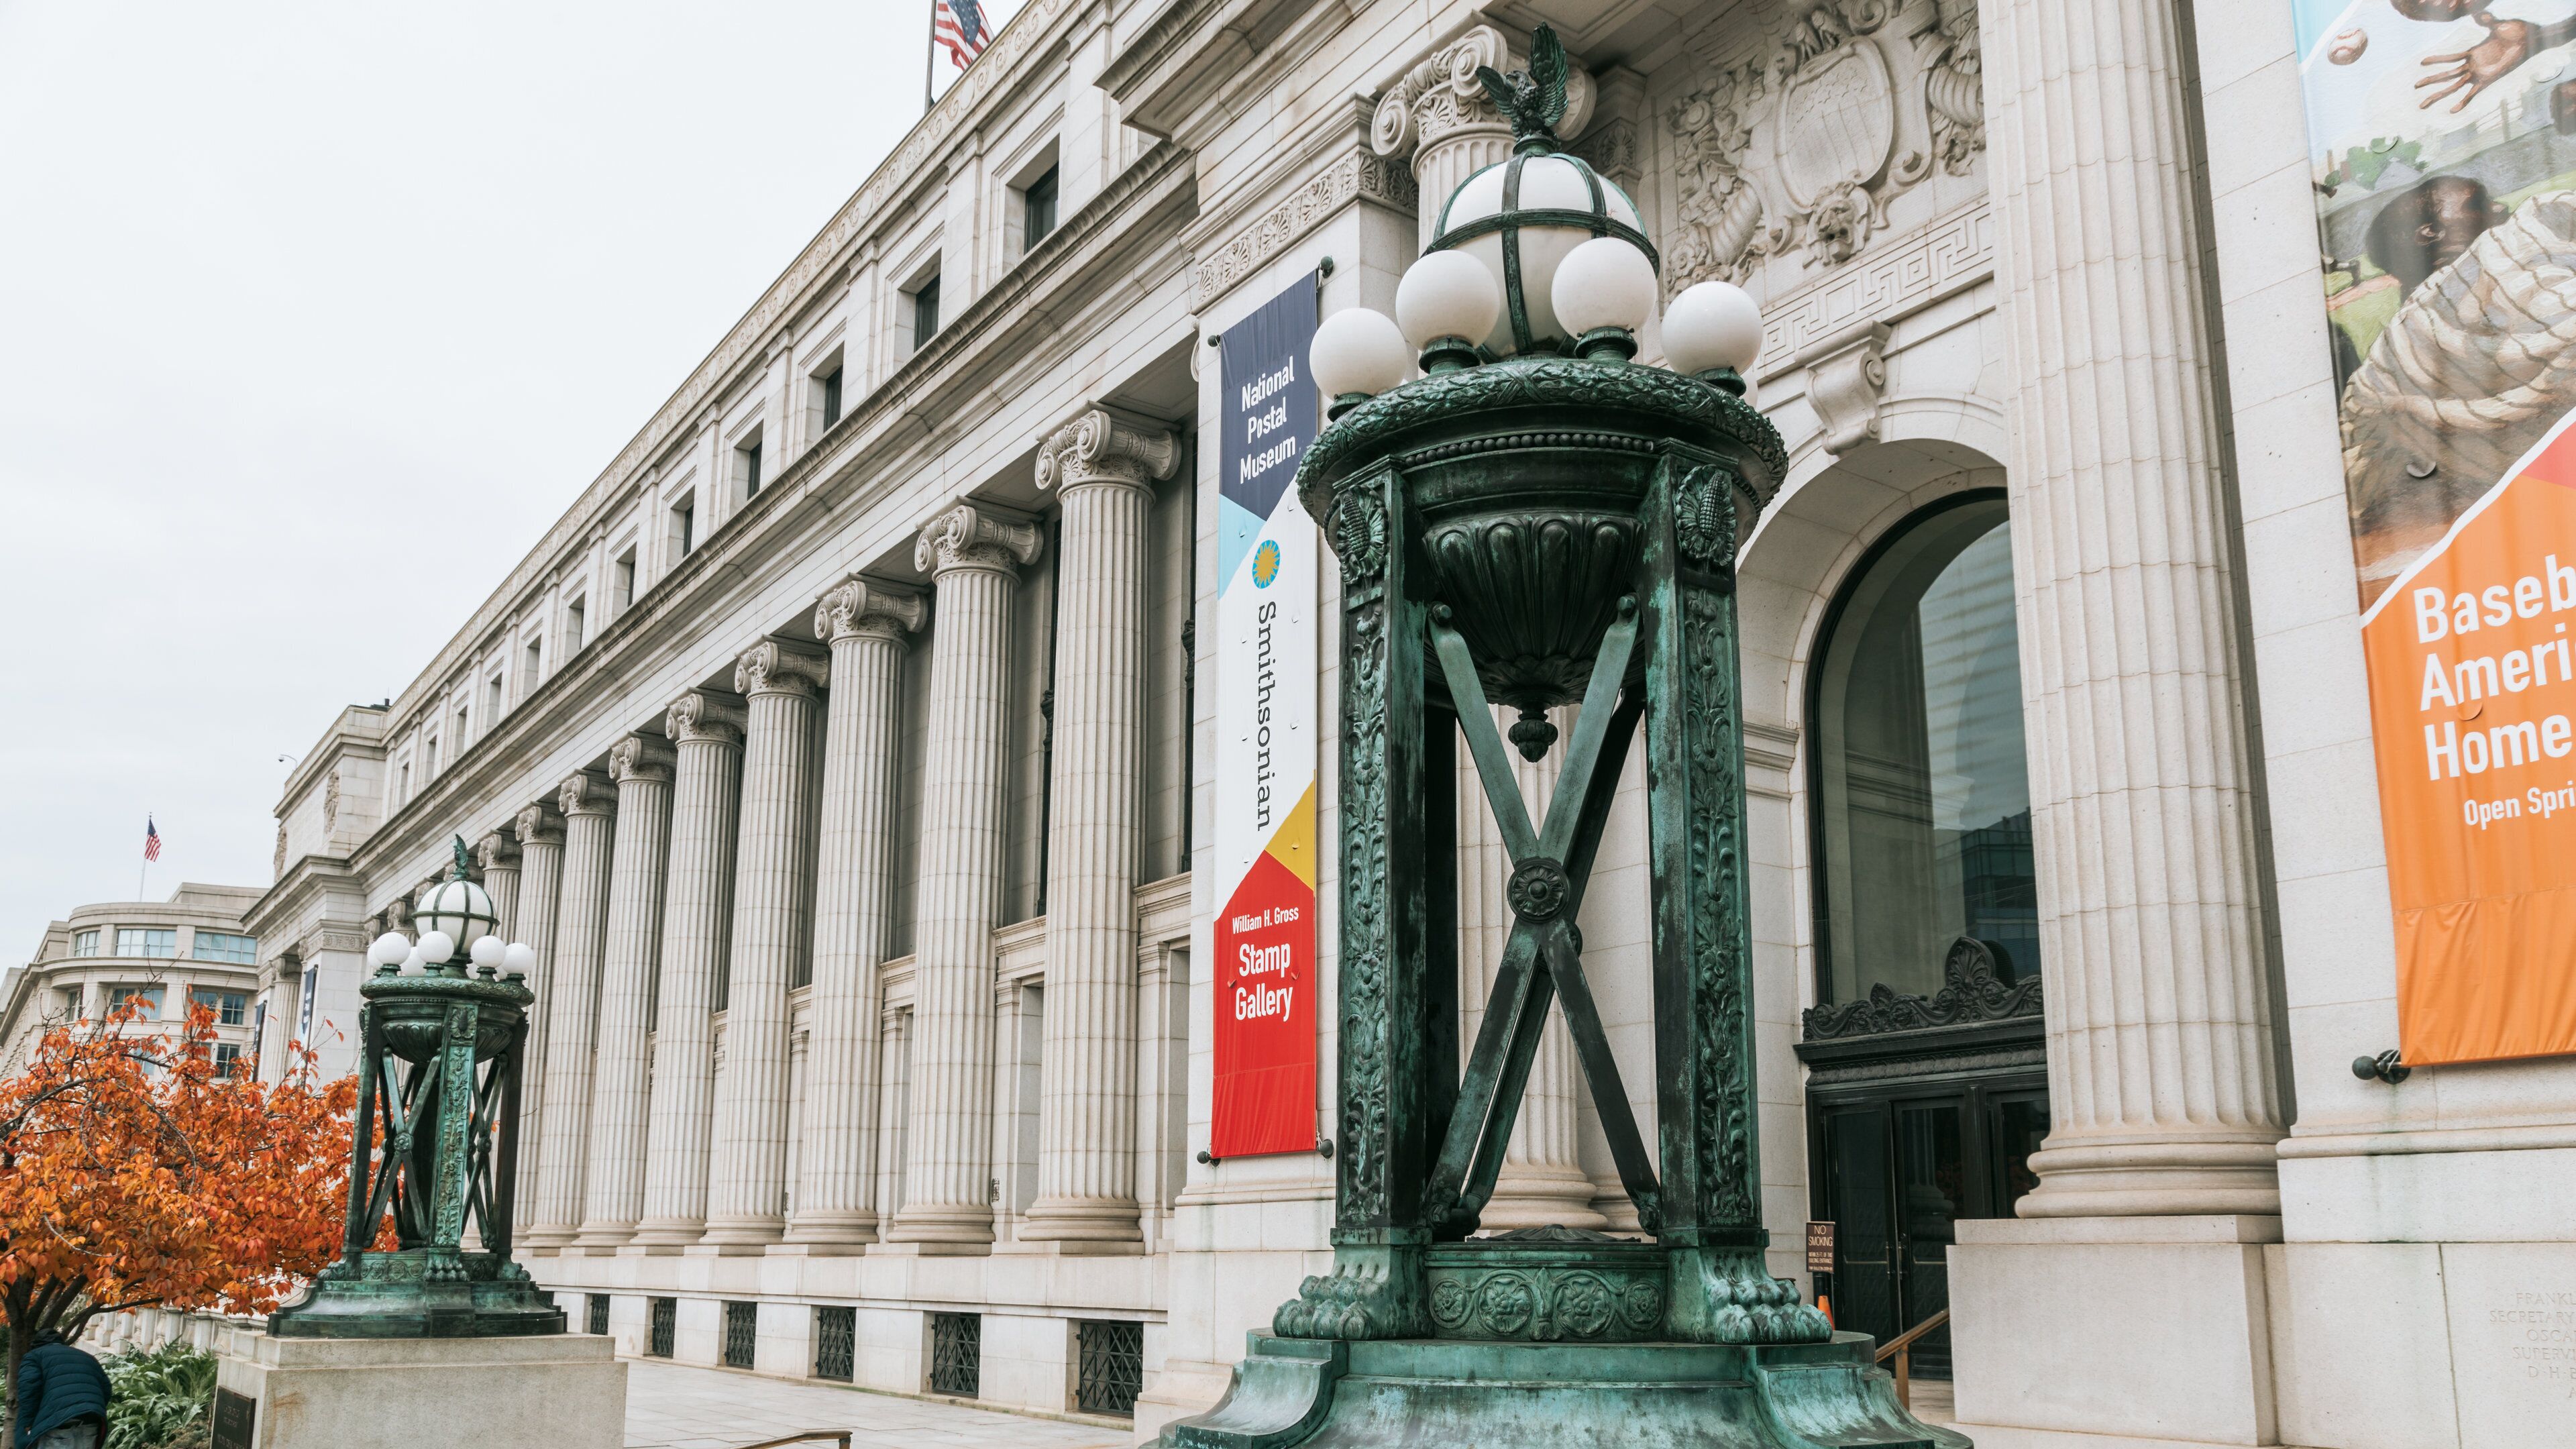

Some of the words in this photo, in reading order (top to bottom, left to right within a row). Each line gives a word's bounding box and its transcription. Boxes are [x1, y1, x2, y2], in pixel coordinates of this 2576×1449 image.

[1242, 355, 1295, 413] National
[1248, 396, 1287, 445] Postal
[1240, 435, 1296, 484] Museum
[2413, 554, 2576, 644] Baseb
[2420, 622, 2576, 712] Ameri
[1257, 601, 1277, 832] Smithsonian
[2424, 714, 2573, 781] Home
[2464, 798, 2521, 830] Open
[2527, 780, 2576, 819] Spri
[1232, 914, 1262, 934] William
[1264, 909, 1273, 927] H.
[1274, 907, 1299, 924] Gross
[1239, 943, 1291, 978] Stamp
[1235, 987, 1293, 1022] Gallery
[1809, 1236, 1833, 1246] SMOKING
[1814, 1225, 1827, 1235] NO
[2489, 1310, 2574, 1324] SECRETARY
